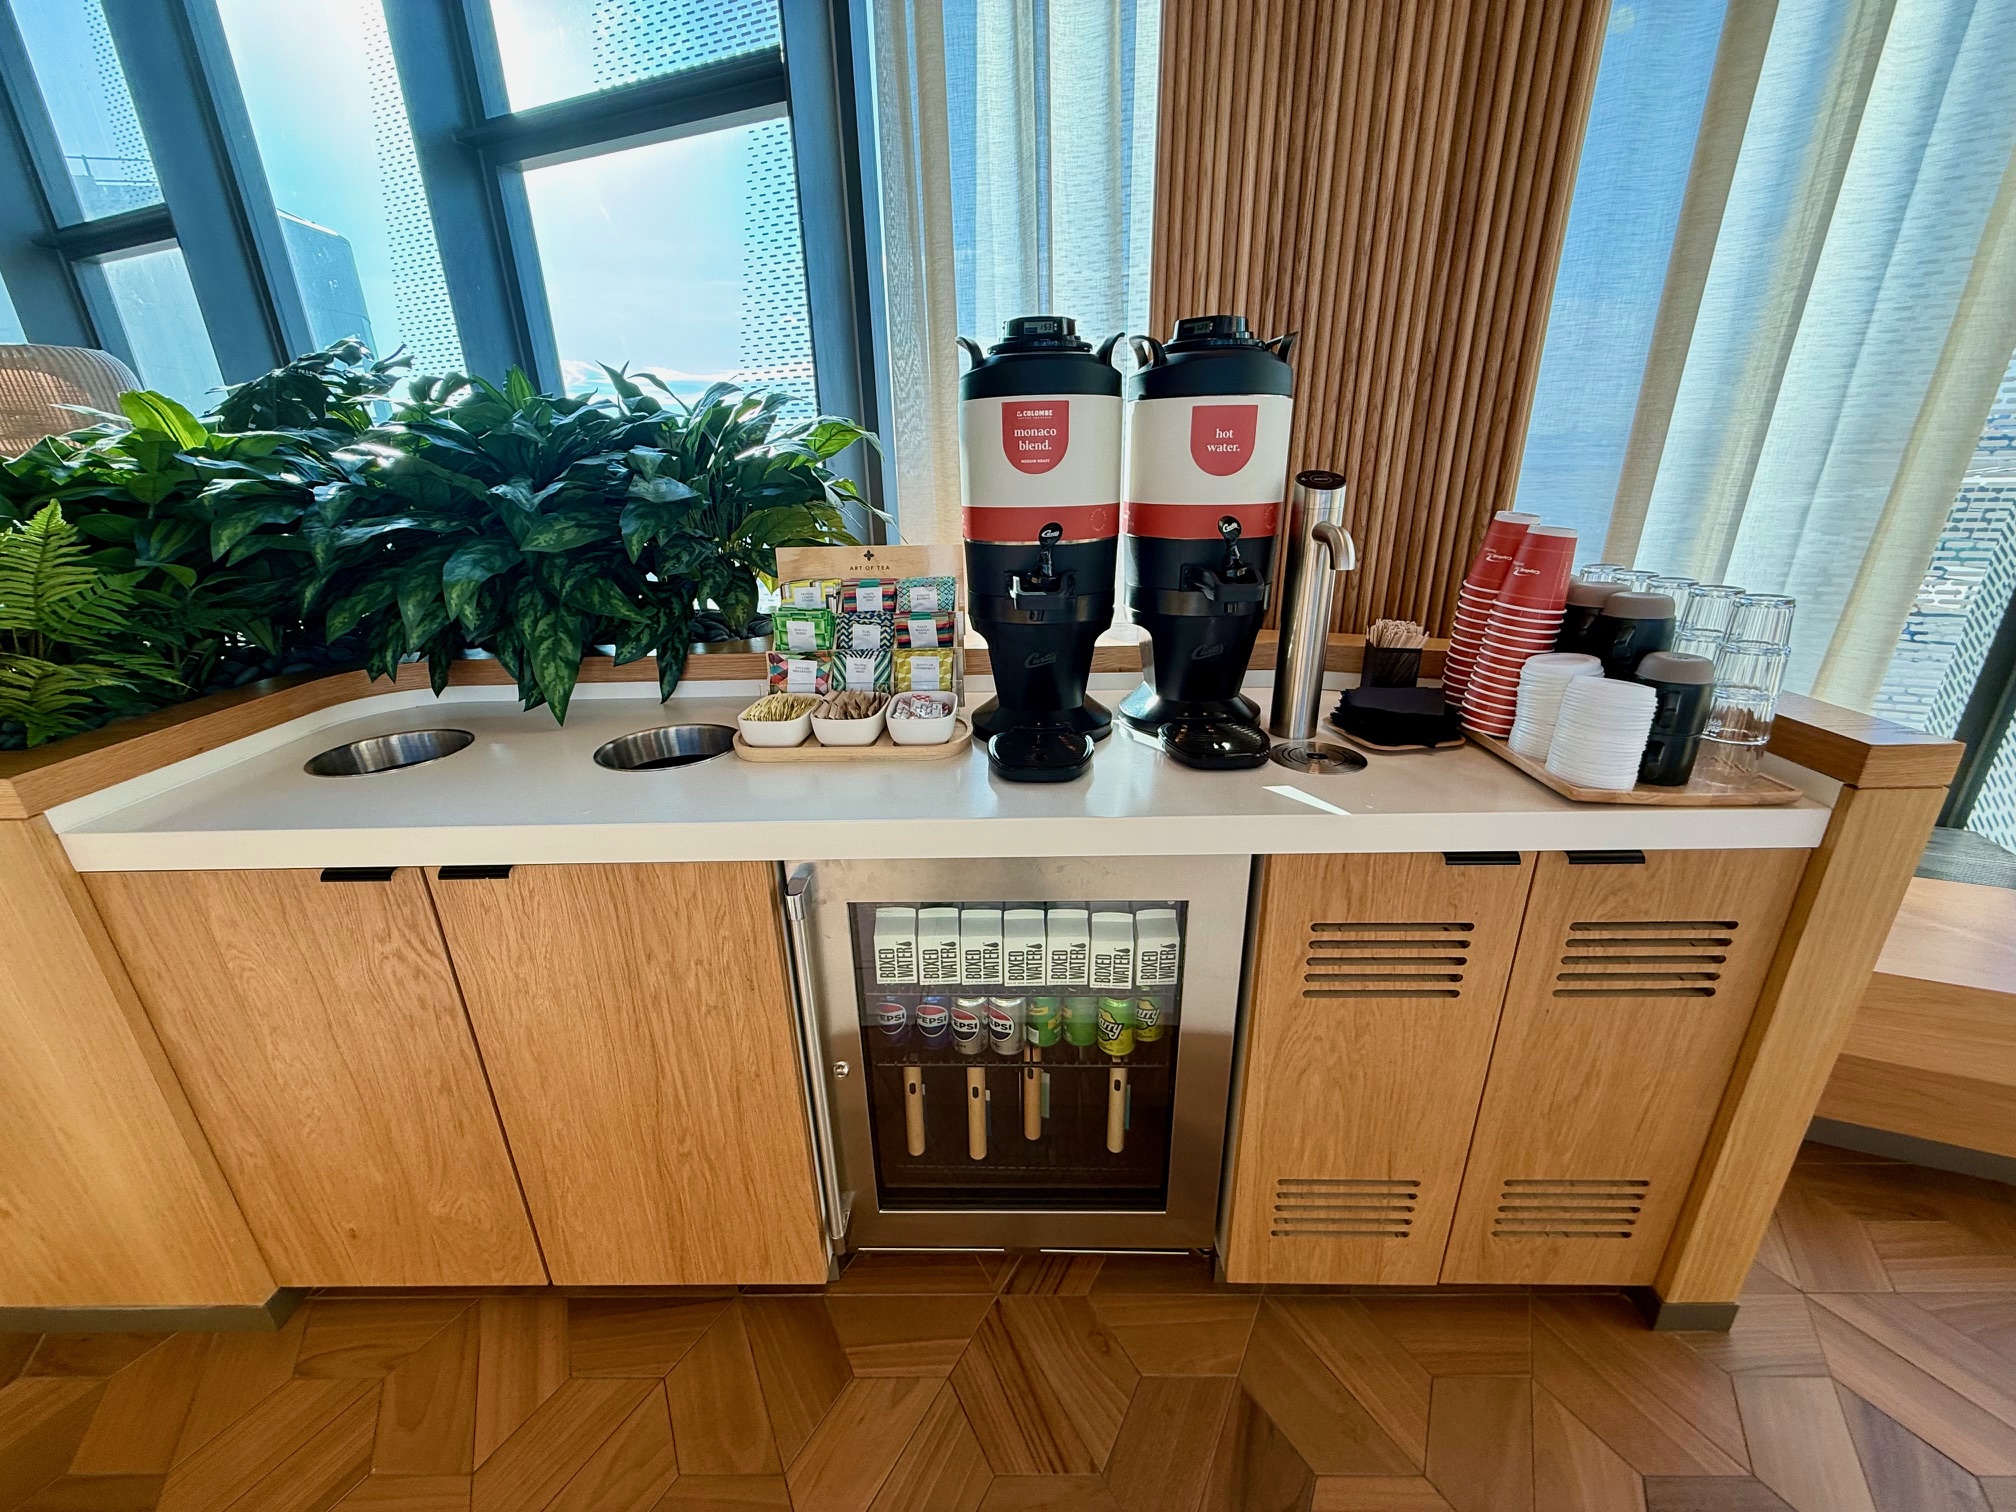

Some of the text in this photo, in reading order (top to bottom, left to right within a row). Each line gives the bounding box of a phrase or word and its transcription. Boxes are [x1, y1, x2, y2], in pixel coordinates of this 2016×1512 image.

[1023, 409, 1053, 417] COLOMBE
[1013, 428, 1057, 437] monaco
[1018, 440, 1052, 451] blend.
[1215, 428, 1234, 439] hot
[1206, 443, 1240, 452] water.
[879, 949, 896, 978] BOXED
[896, 947, 913, 978] WATER
[922, 949, 940, 979] BOXED
[941, 948, 957, 978] WATER
[965, 950, 982, 979] BOXED
[983, 949, 999, 979] WATER
[1008, 951, 1025, 980] BOXED
[1026, 950, 1042, 980] WATER
[1051, 950, 1068, 979] BOXED
[1069, 949, 1086, 979] WATER
[1094, 954, 1112, 983] BOXED
[1112, 953, 1130, 983] WATER
[1141, 951, 1158, 979] BOXED
[1158, 949, 1176, 979] WATER
[880, 1012, 905, 1022] EPSI
[953, 1020, 978, 1030] EPSI
